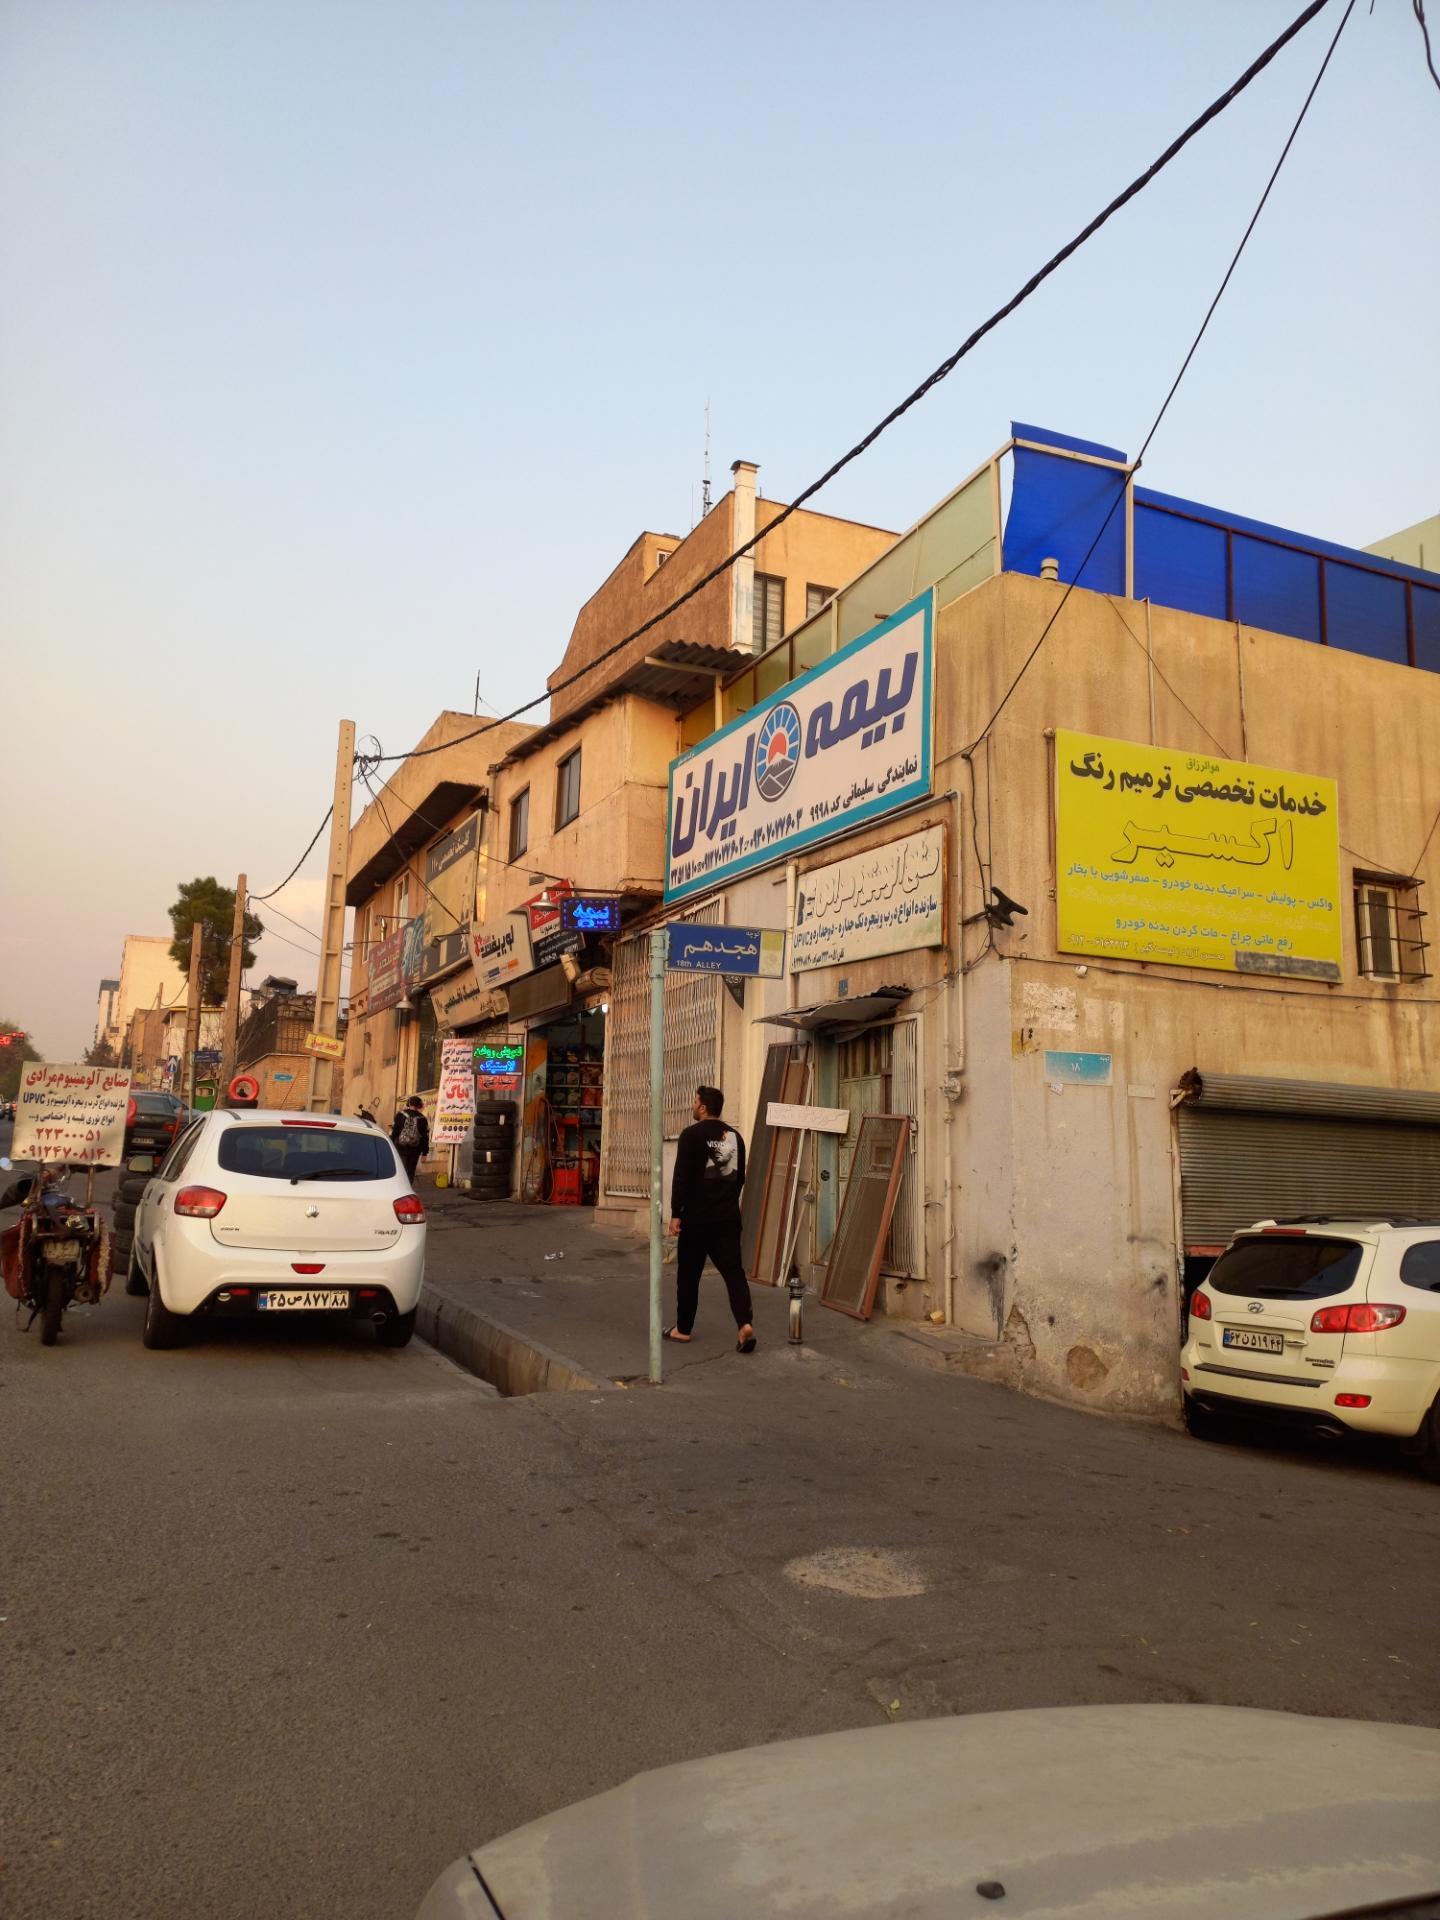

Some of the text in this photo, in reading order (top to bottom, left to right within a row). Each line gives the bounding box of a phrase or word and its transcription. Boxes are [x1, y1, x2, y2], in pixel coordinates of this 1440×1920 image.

[671, 651, 919, 859] بیمه ایران
[877, 753, 918, 794] نمایندگی
[1070, 752, 1327, 816] خدمات تخصصی ترمیم رنگ
[842, 777, 875, 809] سلیمانی
[810, 800, 829, 822] ۹۹۹۸
[830, 795, 841, 813] کد
[1111, 817, 1294, 870] اکسیر
[1067, 863, 1088, 876] بخار
[1090, 864, 1098, 876] با
[1161, 878, 1191, 891] خودرو
[1194, 880, 1215, 893] بدنه
[1217, 883, 1255, 899] سرامیک
[1265, 892, 1297, 908] پولیش
[1308, 897, 1333, 912] واکس
[1116, 917, 1146, 930] خودرو
[1148, 921, 1169, 934] بدنه
[1200, 926, 1218, 938] مات
[1230, 931, 1252, 948] چراغ
[684, 940, 758, 960] هجدهم
[1277, 937, 1293, 952] رفع
[676, 960, 721, 969] 18th ALLEY
[26, 1066, 129, 1091] صنایع آلومینیوم مرادی
[23, 1092, 46, 1104] UPVC
[101, 1115, 115, 1126] انواع
[36, 1127, 101, 1141] ۲۲۳۰۰۰۵۱
[22, 1145, 111, 1159] ۰۹۱۲۴۷۰۸۱۴۰
